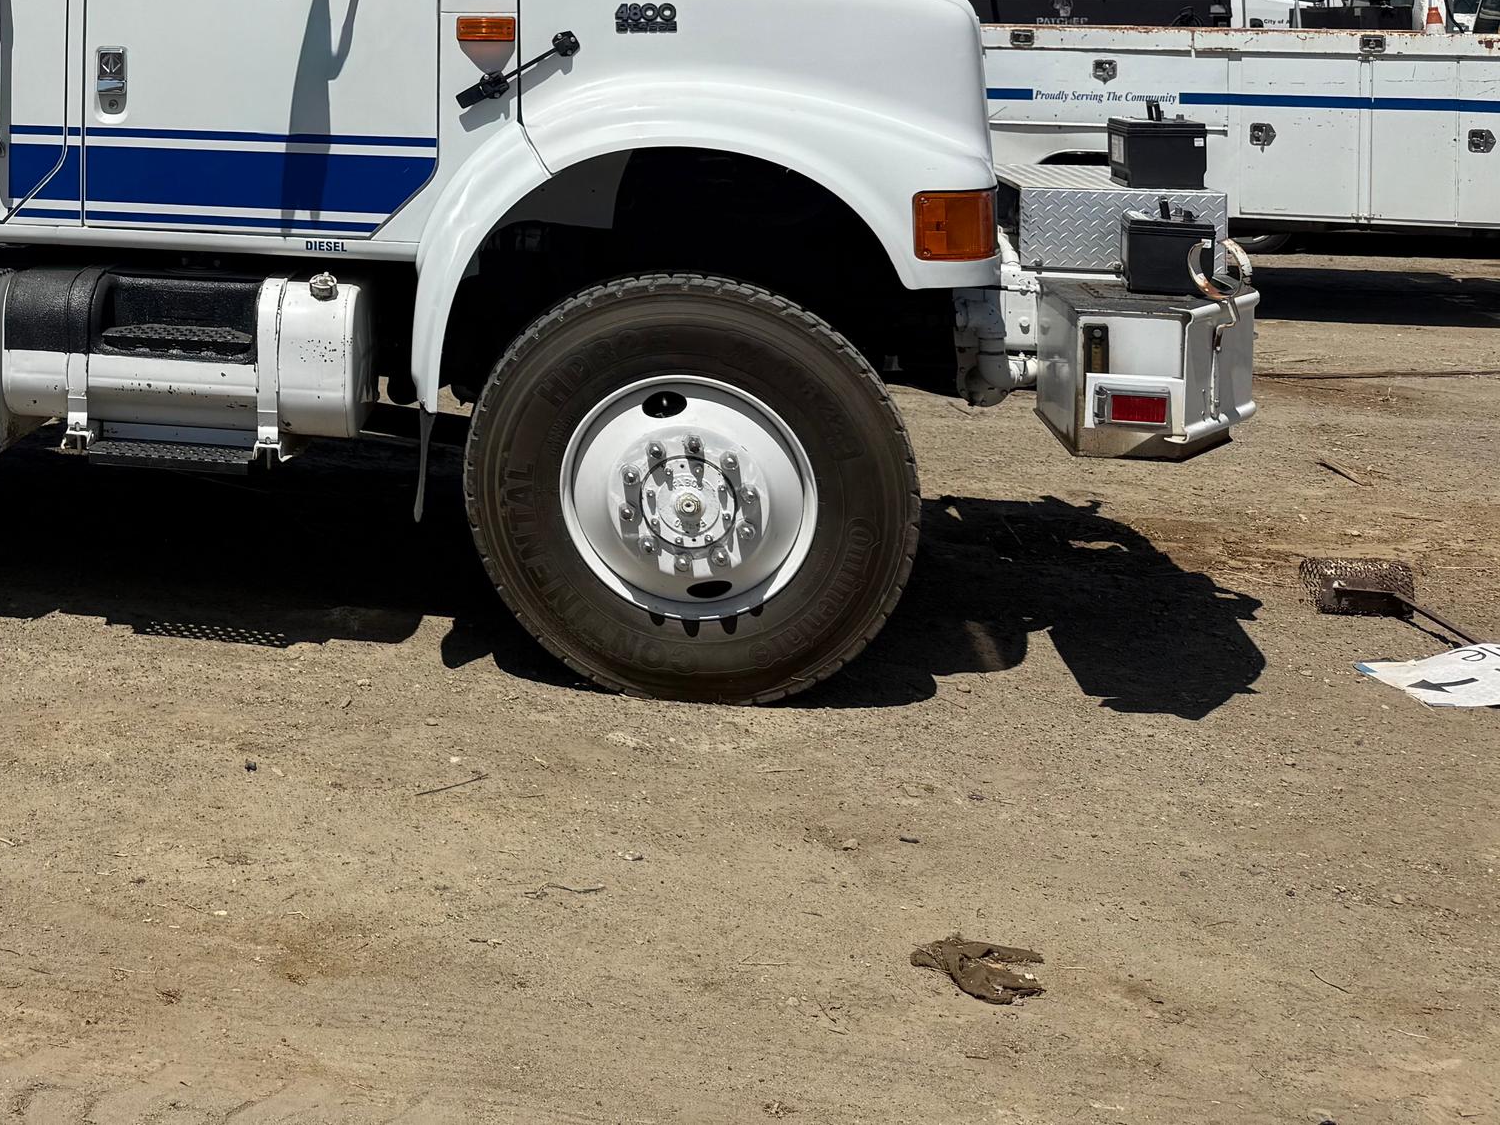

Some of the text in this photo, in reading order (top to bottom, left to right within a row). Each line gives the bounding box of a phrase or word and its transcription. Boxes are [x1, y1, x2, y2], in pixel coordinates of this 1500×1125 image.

[614, 2, 677, 22] 4800
[1034, 89, 1177, 104] Proudly Serving The Community
[305, 240, 348, 253] DIESEL
[503, 461, 705, 672] CONTINENTAL
